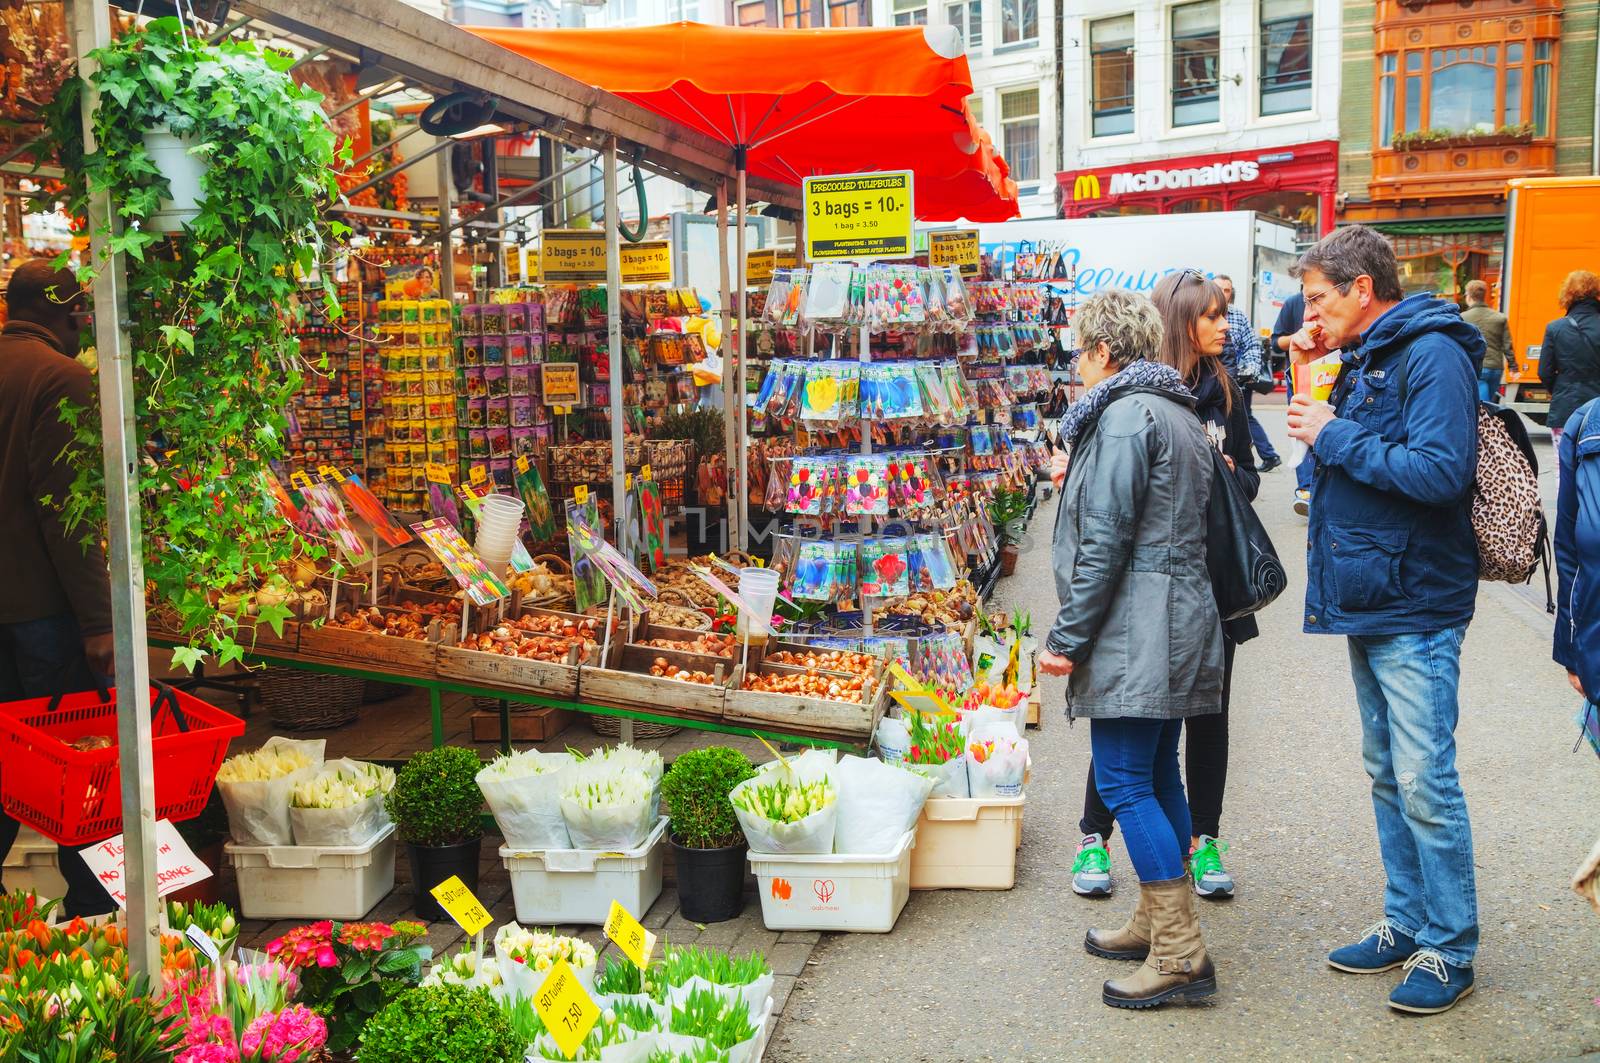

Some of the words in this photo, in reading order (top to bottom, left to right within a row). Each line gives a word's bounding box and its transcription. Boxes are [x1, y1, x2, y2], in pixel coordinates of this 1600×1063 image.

[1108, 160, 1260, 195] McDonald's
[812, 181, 857, 193] PRECOOLED
[812, 201, 821, 216] 3
[825, 200, 860, 219] bags
[864, 201, 872, 210] =
[878, 196, 905, 213] 10.-
[840, 222, 854, 230] bag
[862, 220, 879, 228] 3.50
[546, 247, 552, 256] 3
[554, 246, 578, 259] bags
[940, 243, 953, 252] bag
[622, 255, 627, 263] 3
[628, 255, 646, 265] bags
[933, 254, 939, 263] 3
[940, 253, 958, 263] bags
[441, 891, 454, 904] 50
[464, 905, 485, 924] 7,50
[540, 993, 552, 1012] 50
[548, 974, 567, 1000] Tulpen
[562, 1002, 582, 1032] 7,50
